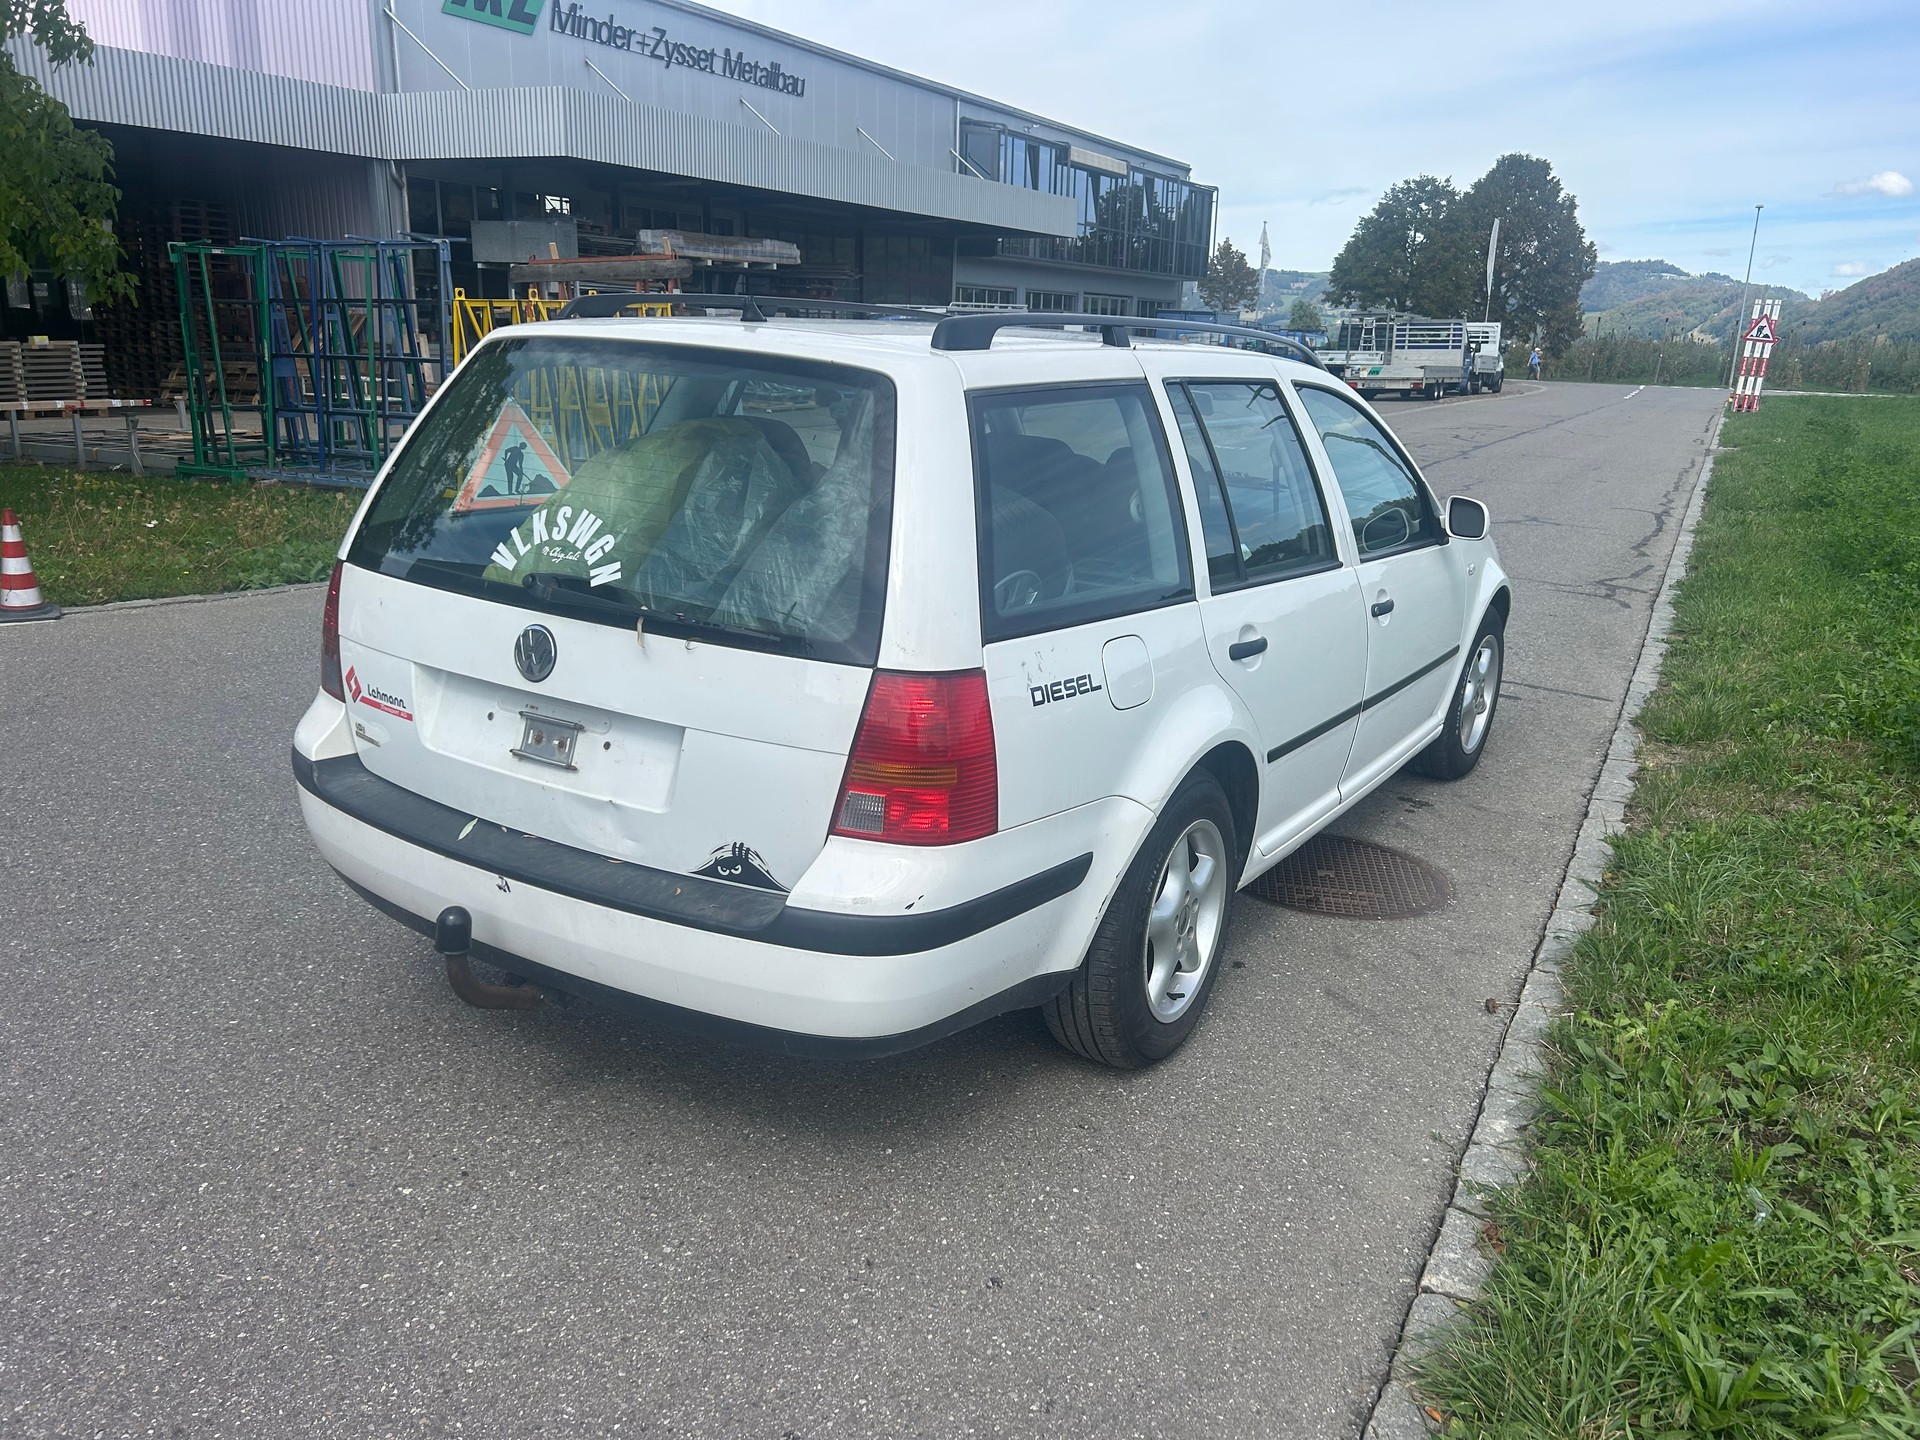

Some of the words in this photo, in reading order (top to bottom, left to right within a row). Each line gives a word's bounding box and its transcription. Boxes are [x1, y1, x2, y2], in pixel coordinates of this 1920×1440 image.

[550, 2, 717, 74] Minder+Zysset
[722, 47, 806, 98] Metallbau
[490, 505, 622, 588] VLKSWGN
[515, 626, 556, 681] VW
[367, 683, 407, 709] Lehmann
[1029, 673, 1103, 707] DIESEL
